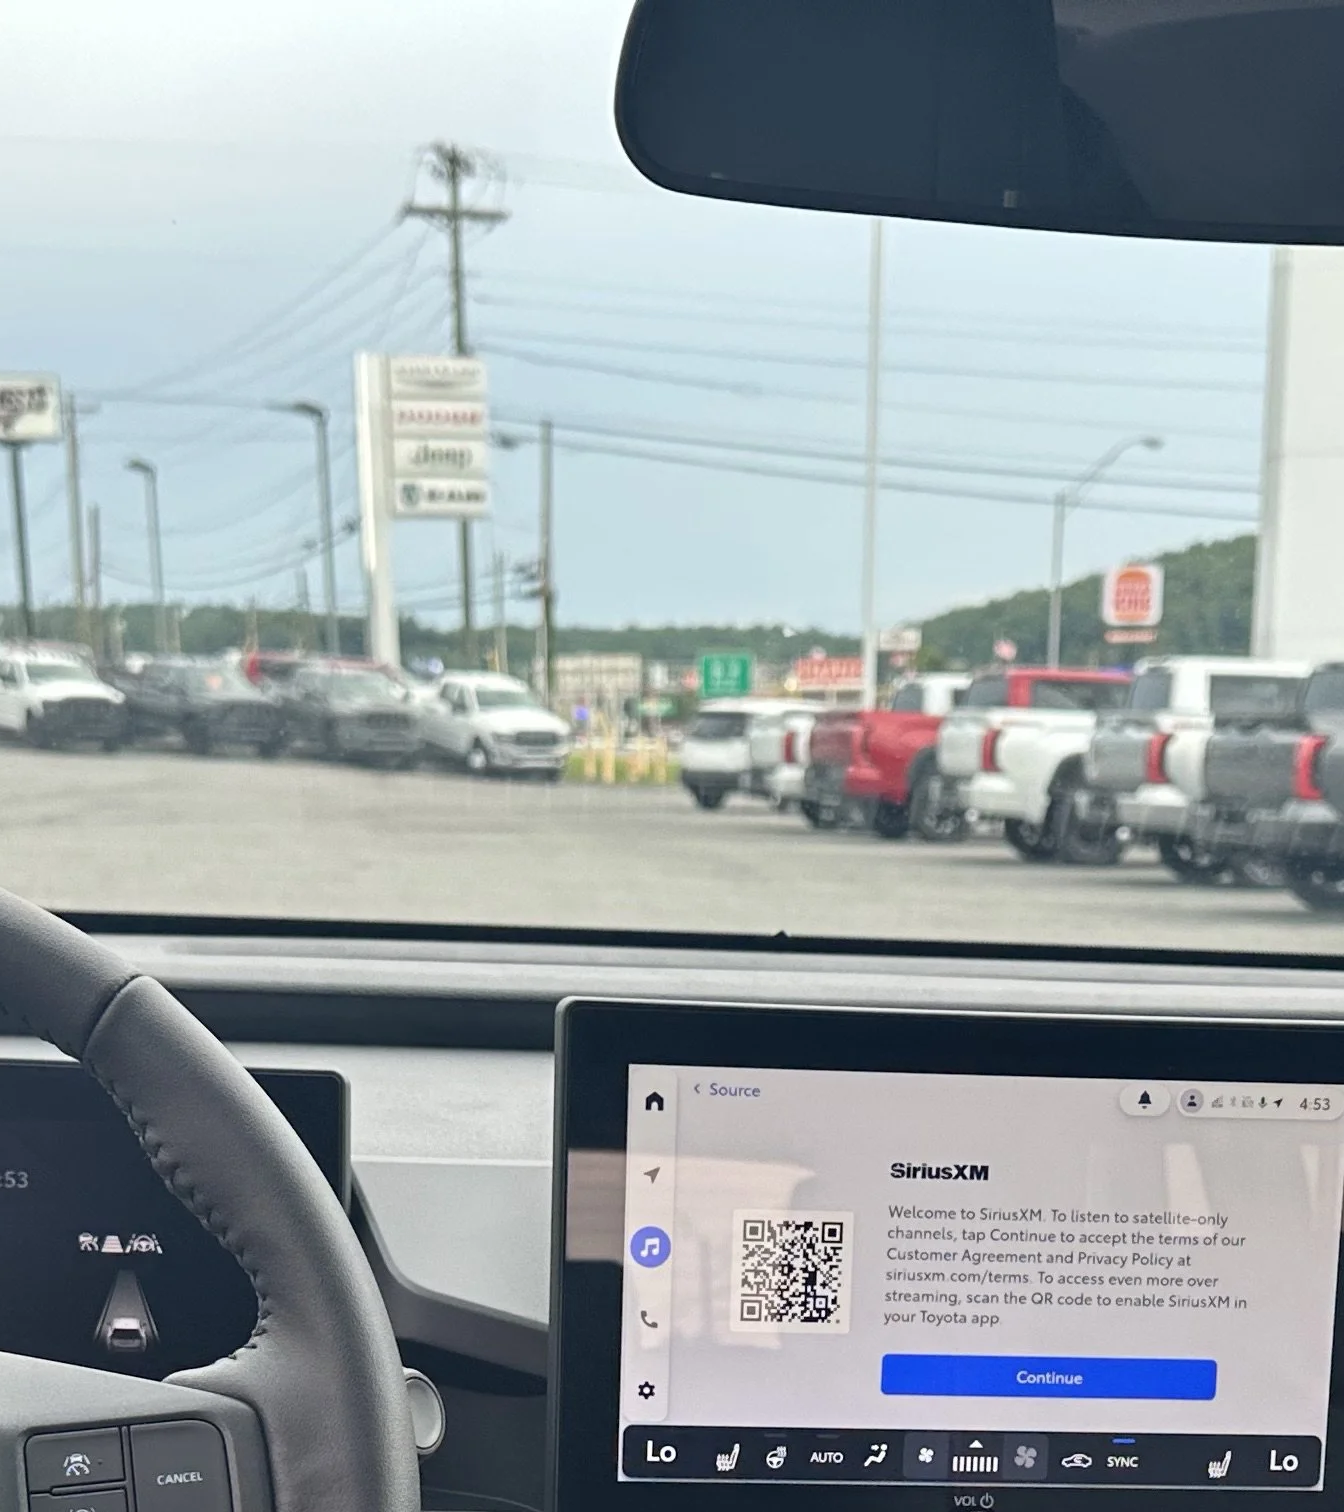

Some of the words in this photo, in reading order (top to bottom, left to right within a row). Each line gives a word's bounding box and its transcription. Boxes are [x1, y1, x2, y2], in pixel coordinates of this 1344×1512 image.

[710, 1083, 761, 1098] Source
[1299, 1098, 1331, 1111] 4:53
[890, 1163, 990, 1181] SiriusXM
[888, 1206, 956, 1220] Welcome
[961, 1208, 975, 1221] to
[1052, 1209, 1067, 1222] To
[1071, 1210, 1110, 1224] listen
[1114, 1212, 1129, 1224] to
[1133, 1212, 1229, 1229] satellite-only
[888, 1226, 958, 1241] channels,
[962, 1229, 986, 1244] tap
[990, 1229, 1056, 1243] Continue
[1061, 1231, 1075, 1243] to
[1079, 1232, 1127, 1247] accept
[1131, 1232, 1154, 1245] the
[1158, 1234, 1199, 1246] terms
[1203, 1233, 1218, 1246] of
[1221, 1236, 1246, 1247] our
[886, 1248, 958, 1262] Customer
[962, 1249, 1042, 1266] Agreement
[1046, 1251, 1073, 1264] and
[1078, 1252, 1128, 1268] Privacy
[1132, 1253, 1174, 1269] Policy
[1177, 1255, 1191, 1267] at
[1038, 1271, 1054, 1284] To
[1058, 1274, 1104, 1286] access
[1109, 1276, 1142, 1286] even
[1146, 1277, 1184, 1287] more
[1187, 1277, 1219, 1287] over
[885, 1291, 962, 1307] streaming,
[966, 1294, 999, 1304] scan
[1004, 1292, 1027, 1305] the
[1031, 1292, 1053, 1306] QR
[1057, 1293, 1093, 1306] code
[1097, 1295, 1112, 1307] to
[1115, 1294, 1164, 1308] enable
[1168, 1295, 1230, 1309] SiriusXM
[1234, 1296, 1248, 1309] in
[883, 1312, 916, 1326] your
[920, 1311, 967, 1327] Toyota
[1016, 1370, 1084, 1385] Continue
[646, 1440, 677, 1463] Lo
[810, 1451, 844, 1465] AUTO
[1107, 1456, 1139, 1468] SYNC
[1269, 1450, 1299, 1473] Lo
[157, 1471, 203, 1486] CANCEL
[954, 1495, 977, 1507] VOL
